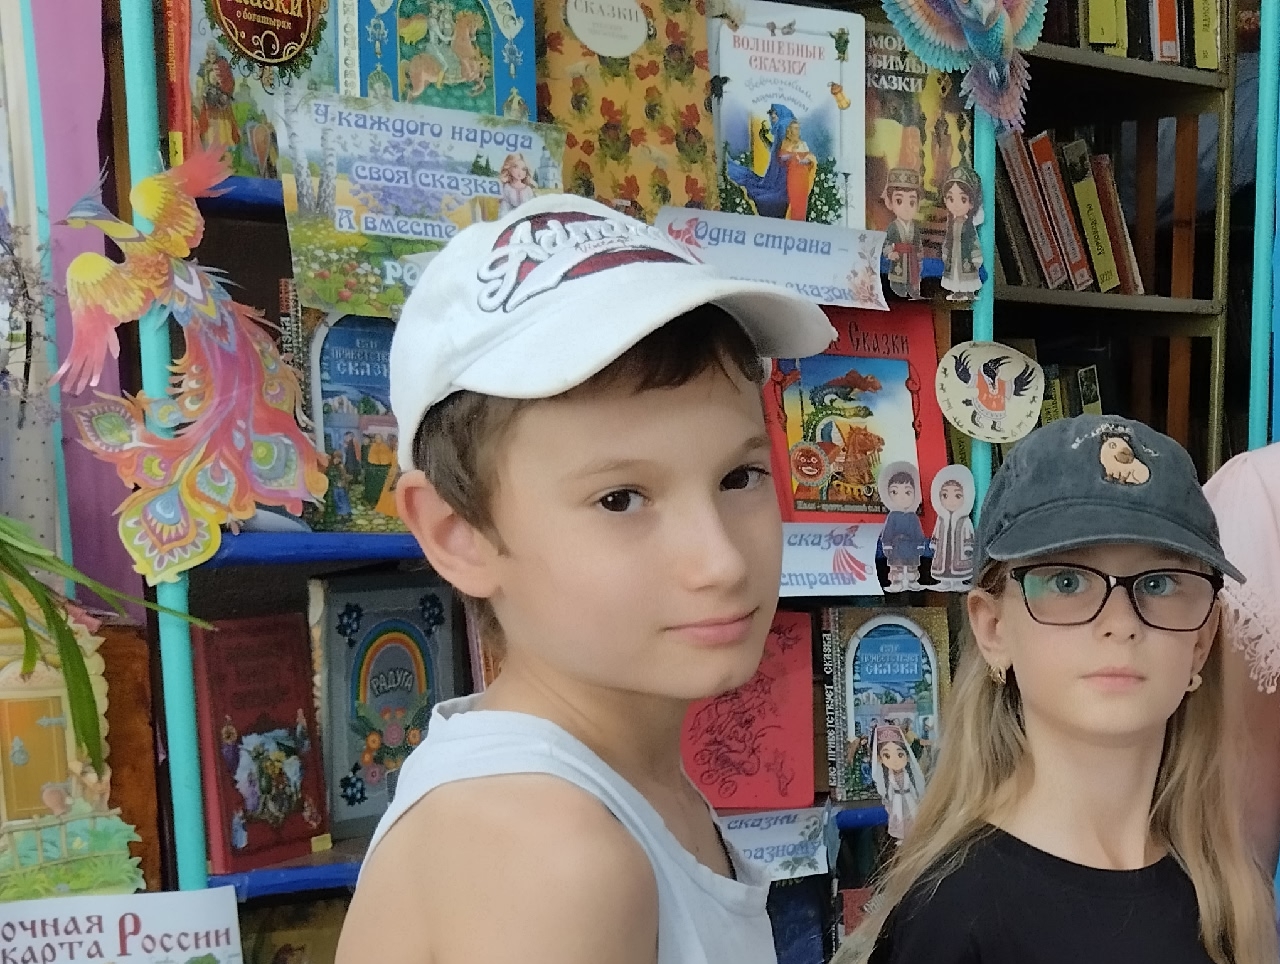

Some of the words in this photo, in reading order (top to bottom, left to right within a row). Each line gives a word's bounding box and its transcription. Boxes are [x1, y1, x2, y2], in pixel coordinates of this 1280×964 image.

[732, 35, 825, 60] ВОЛШЕБНЫЕ
[749, 54, 807, 76] СКАЗКИ
[314, 103, 331, 125] У
[338, 109, 443, 138] каждого
[451, 120, 533, 150] народа
[355, 164, 409, 185] своя
[418, 171, 501, 197] сказка
[337, 208, 355, 231] А
[365, 217, 457, 238] вместе
[695, 220, 746, 246] Одна
[753, 232, 832, 257] страна
[848, 321, 910, 355] Сказки
[787, 532, 856, 550] сказок
[780, 572, 857, 590] страны
[727, 813, 798, 831] сказки
[1, 914, 104, 943] очная
[117, 912, 232, 957] России
